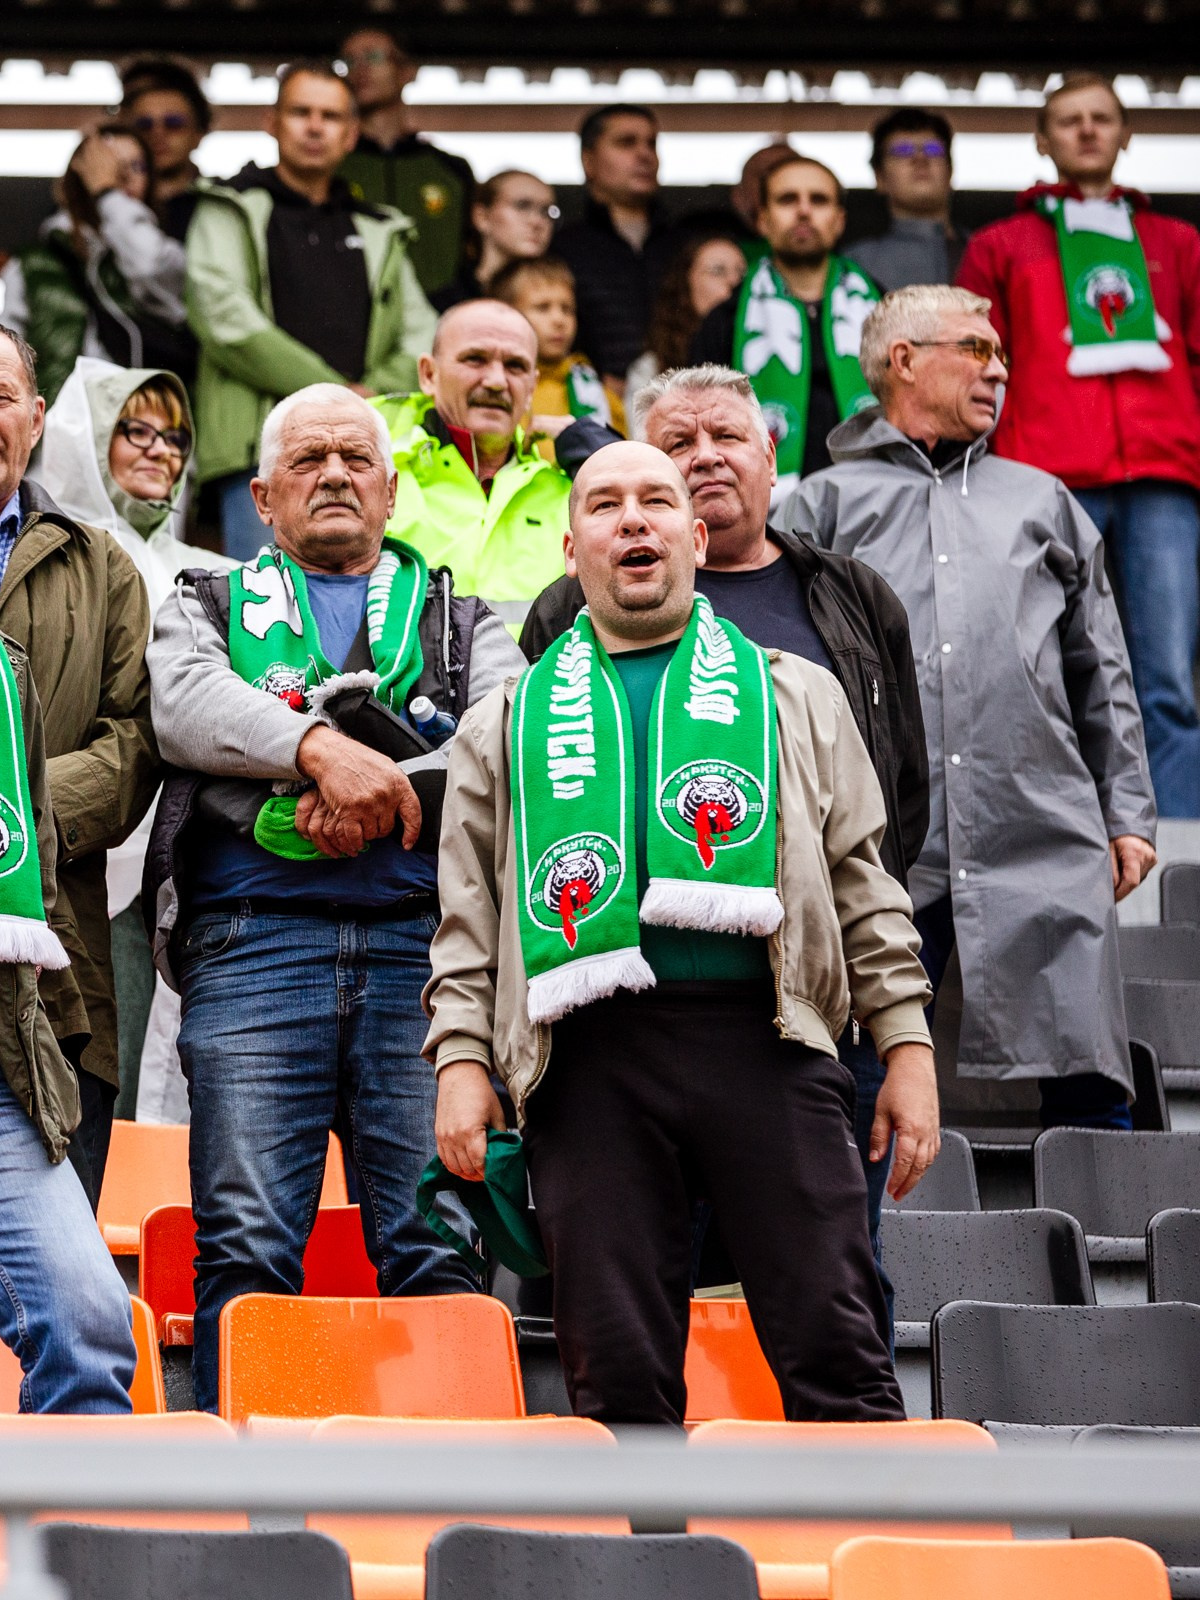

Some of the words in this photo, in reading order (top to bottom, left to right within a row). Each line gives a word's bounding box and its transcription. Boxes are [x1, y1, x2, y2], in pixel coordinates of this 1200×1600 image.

[680, 764, 745, 785] ИРКУТСК
[661, 798, 676, 808] 20
[748, 802, 762, 813] 20
[10, 830, 23, 842] 20
[544, 837, 603, 867] ИРКУТСК
[607, 863, 620, 876] 20
[531, 890, 543, 904] 20
